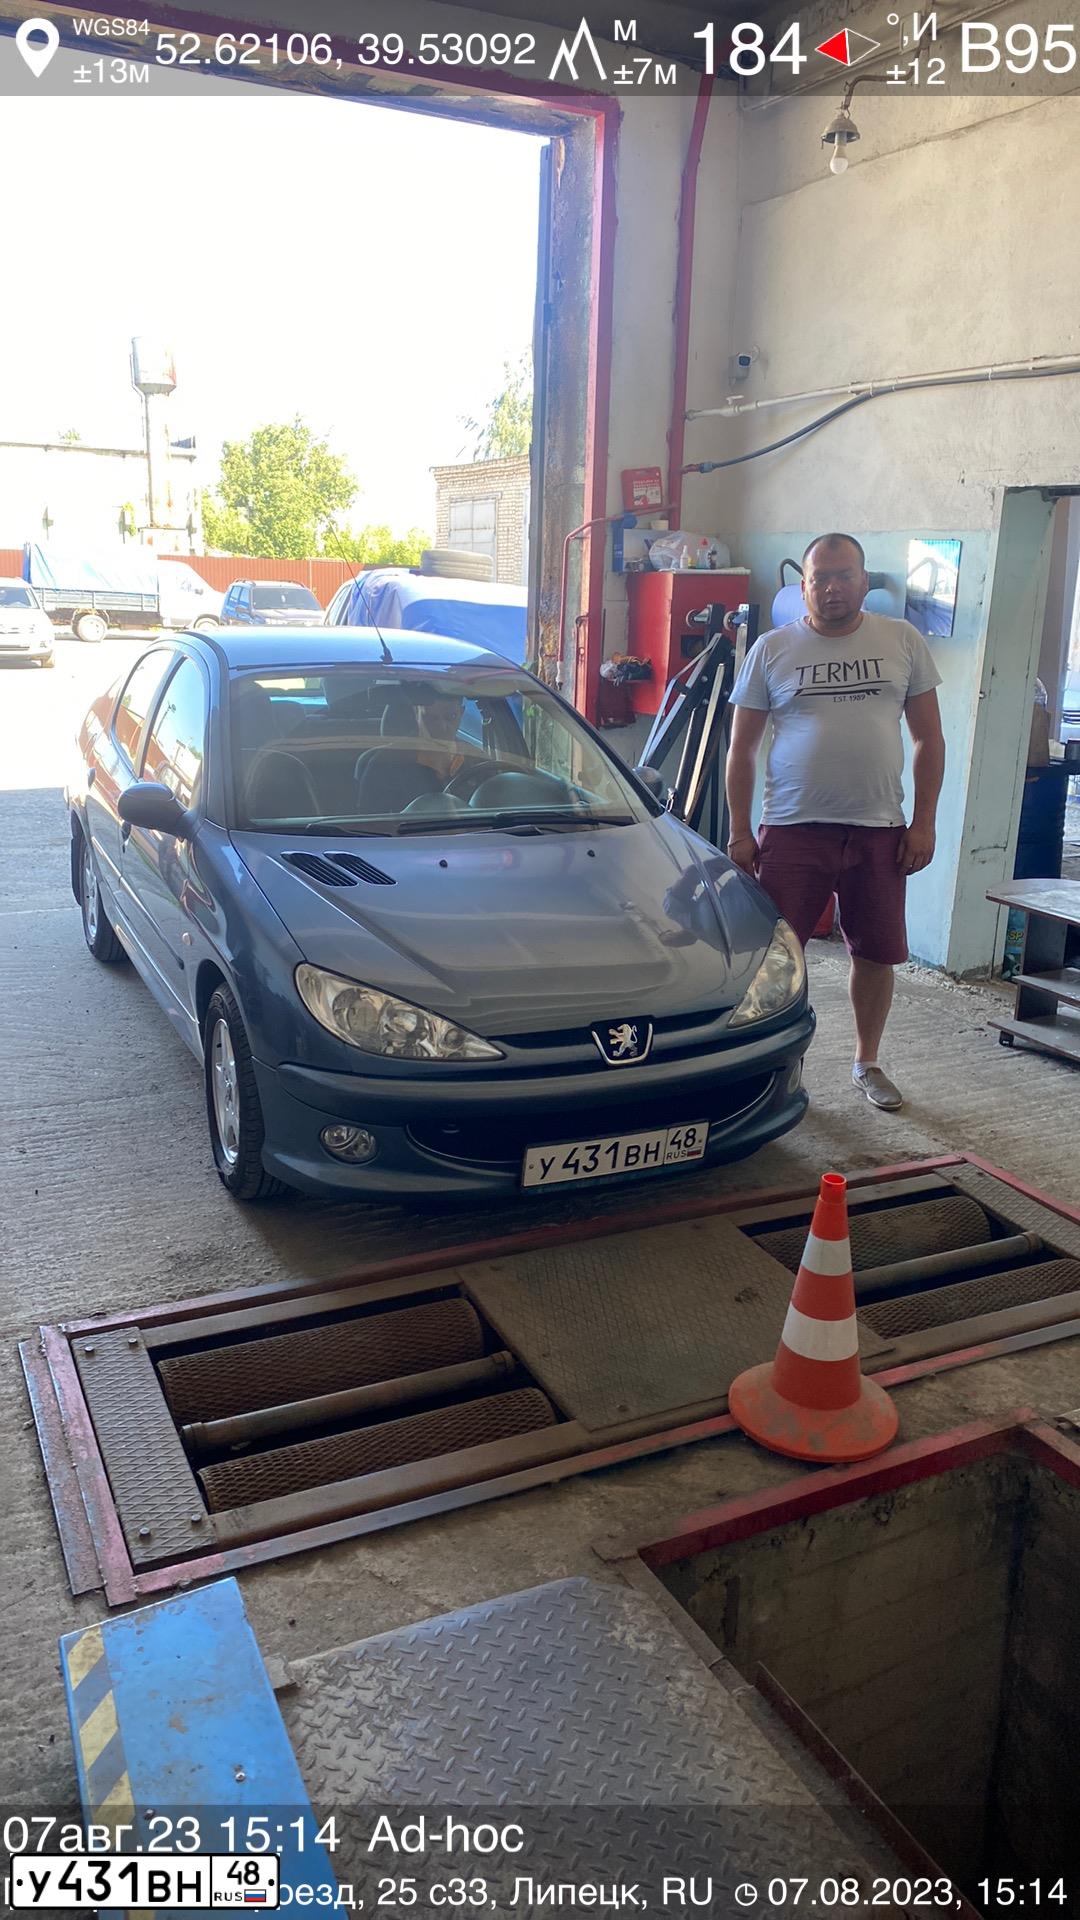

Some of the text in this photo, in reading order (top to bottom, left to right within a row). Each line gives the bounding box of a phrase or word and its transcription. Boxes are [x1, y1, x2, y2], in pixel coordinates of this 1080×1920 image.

[795, 658, 884, 686] TERMIT
[670, 1127, 697, 1150] 48
[666, 1149, 687, 1161] RUS
